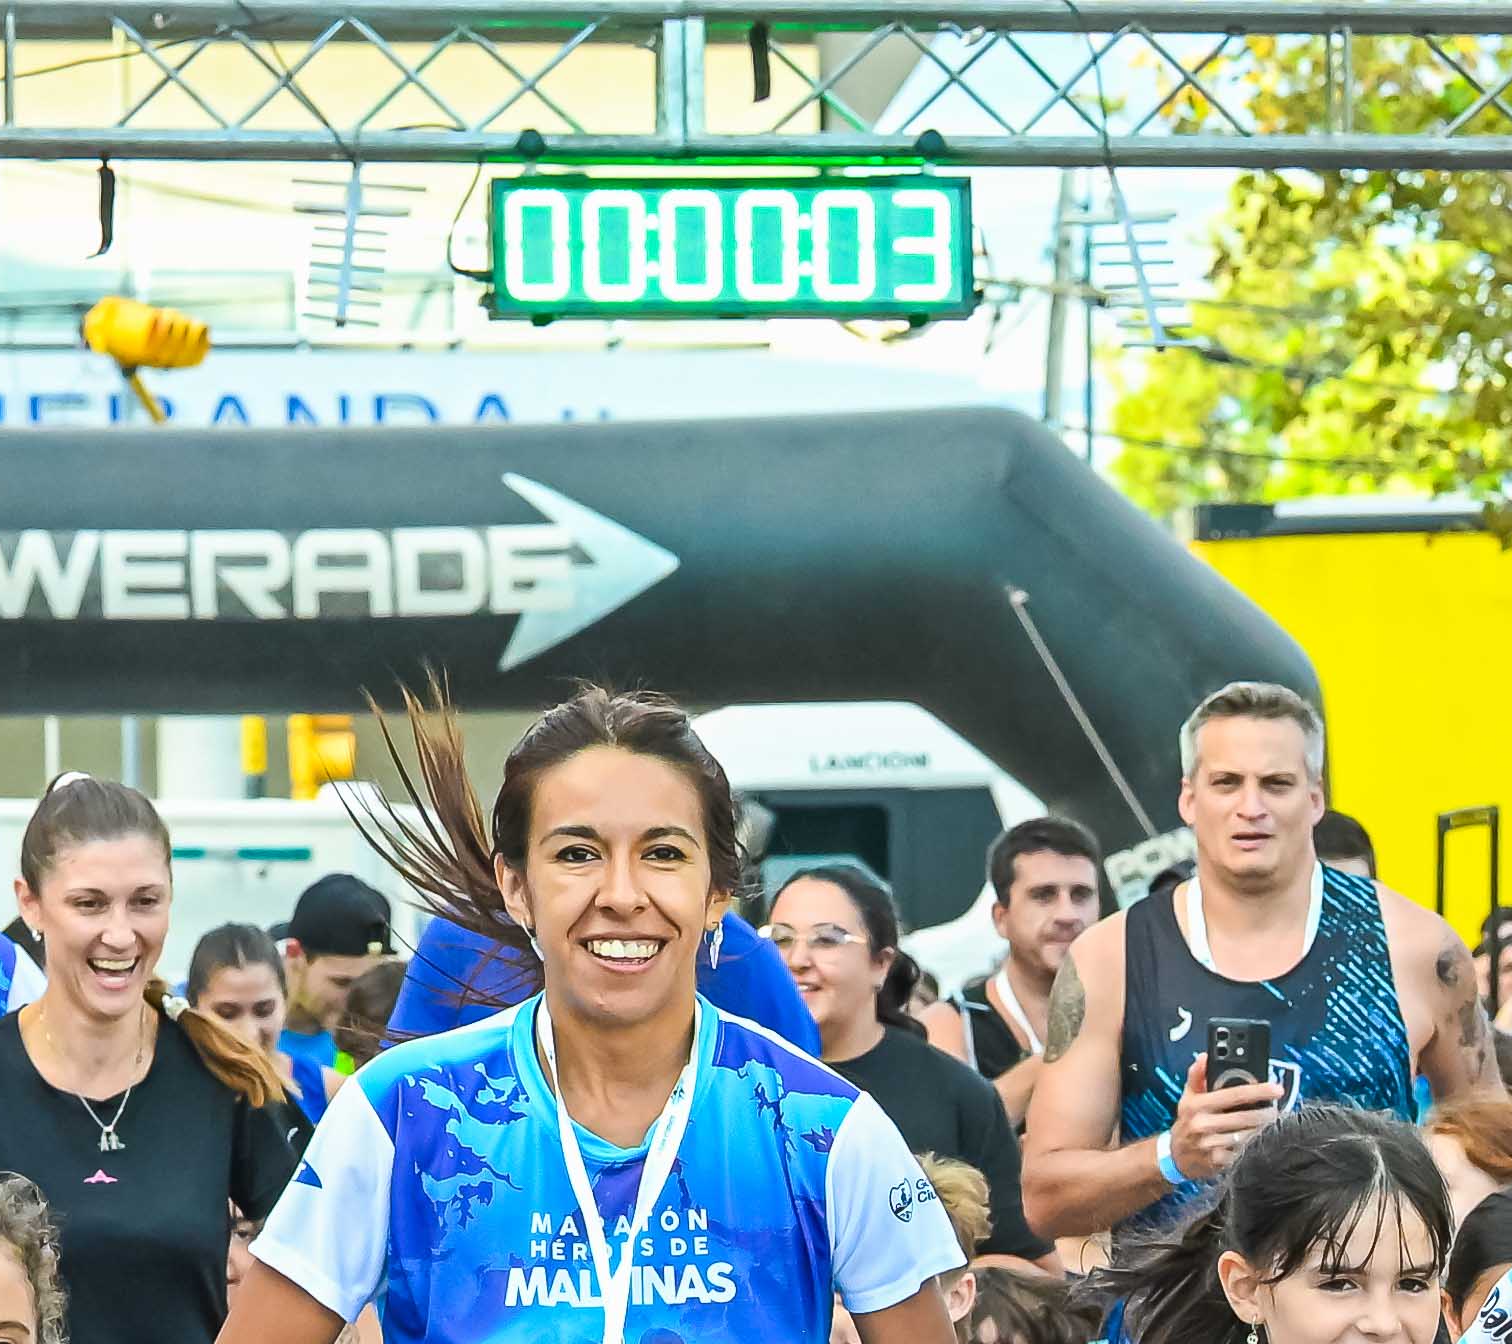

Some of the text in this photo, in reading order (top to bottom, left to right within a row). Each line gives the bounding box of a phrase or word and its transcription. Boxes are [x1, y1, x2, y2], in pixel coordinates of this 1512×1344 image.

[505, 189, 951, 302] 00:00:03
[669, 1236, 709, 1257] DE
[504, 1261, 738, 1309] MALINAS
